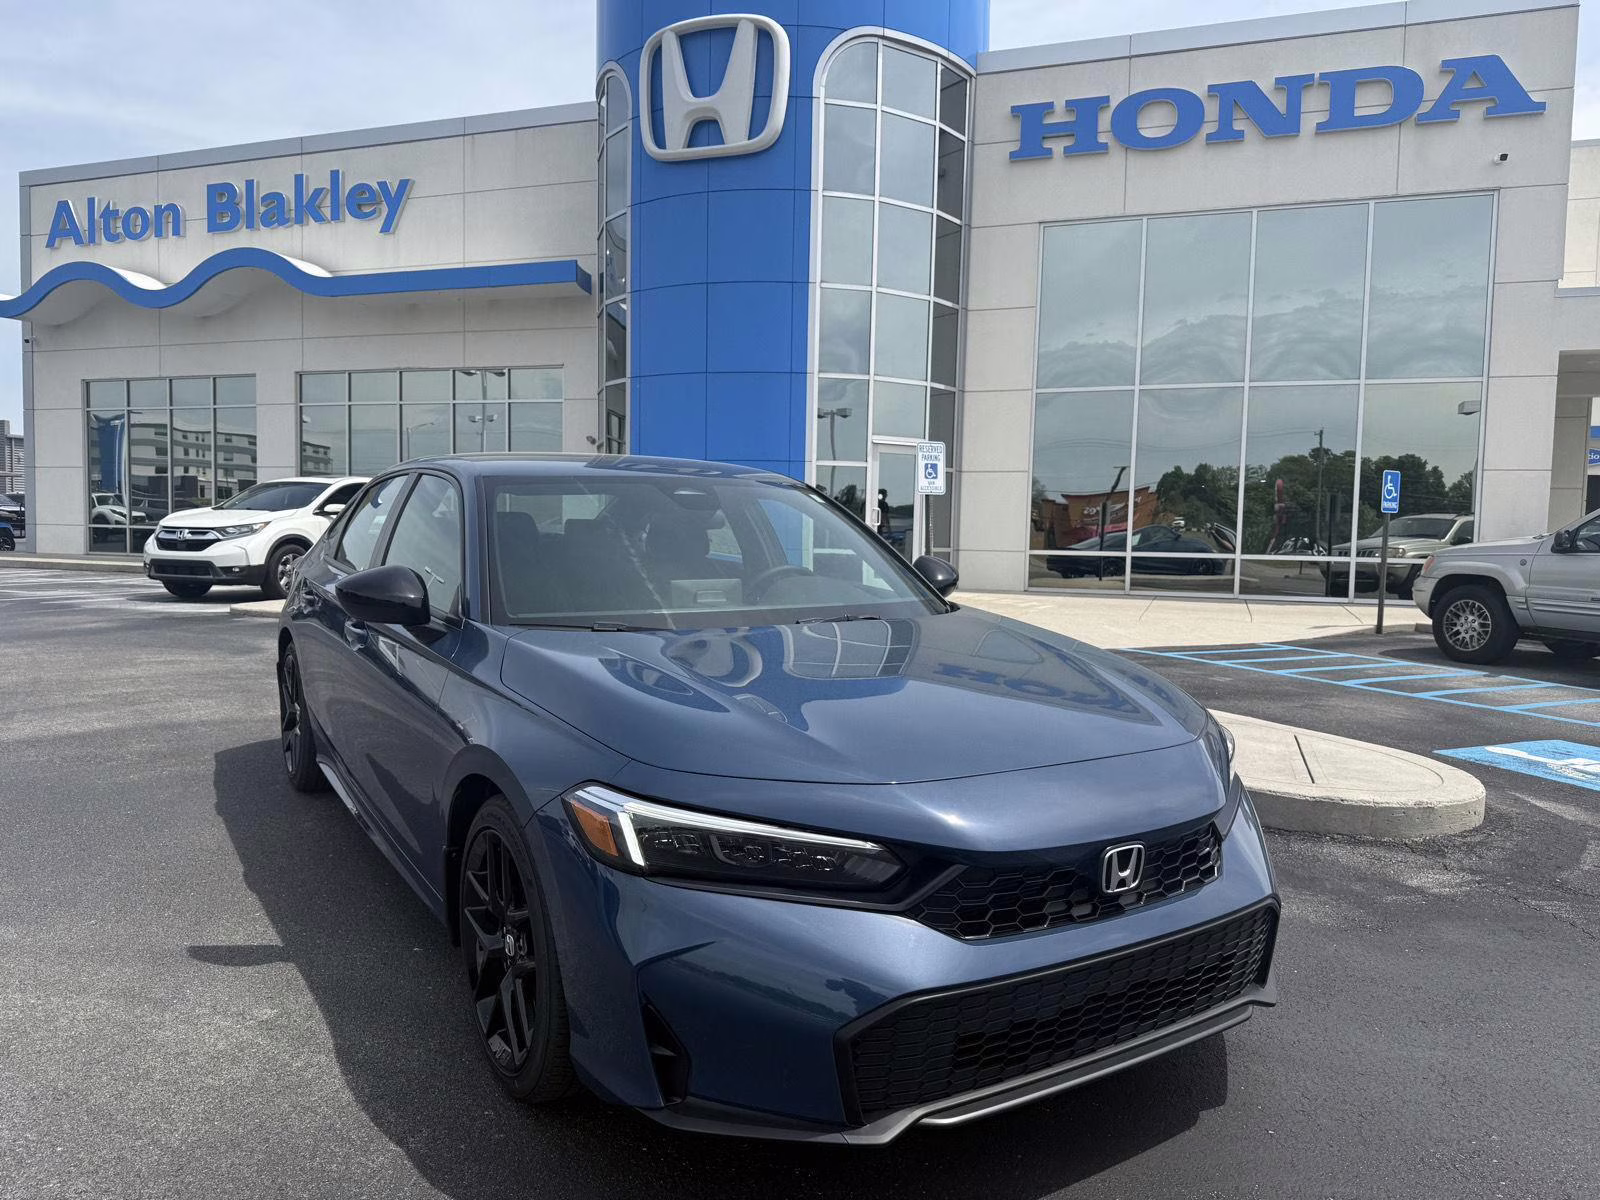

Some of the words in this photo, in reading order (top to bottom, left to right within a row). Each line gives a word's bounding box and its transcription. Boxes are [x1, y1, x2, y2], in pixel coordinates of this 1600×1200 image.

[1009, 54, 1546, 161] HONDA
[45, 196, 184, 249] Alton
[206, 169, 413, 234] Blakley
[919, 445, 943, 454] RESERVED
[921, 454, 941, 462] PARKING
